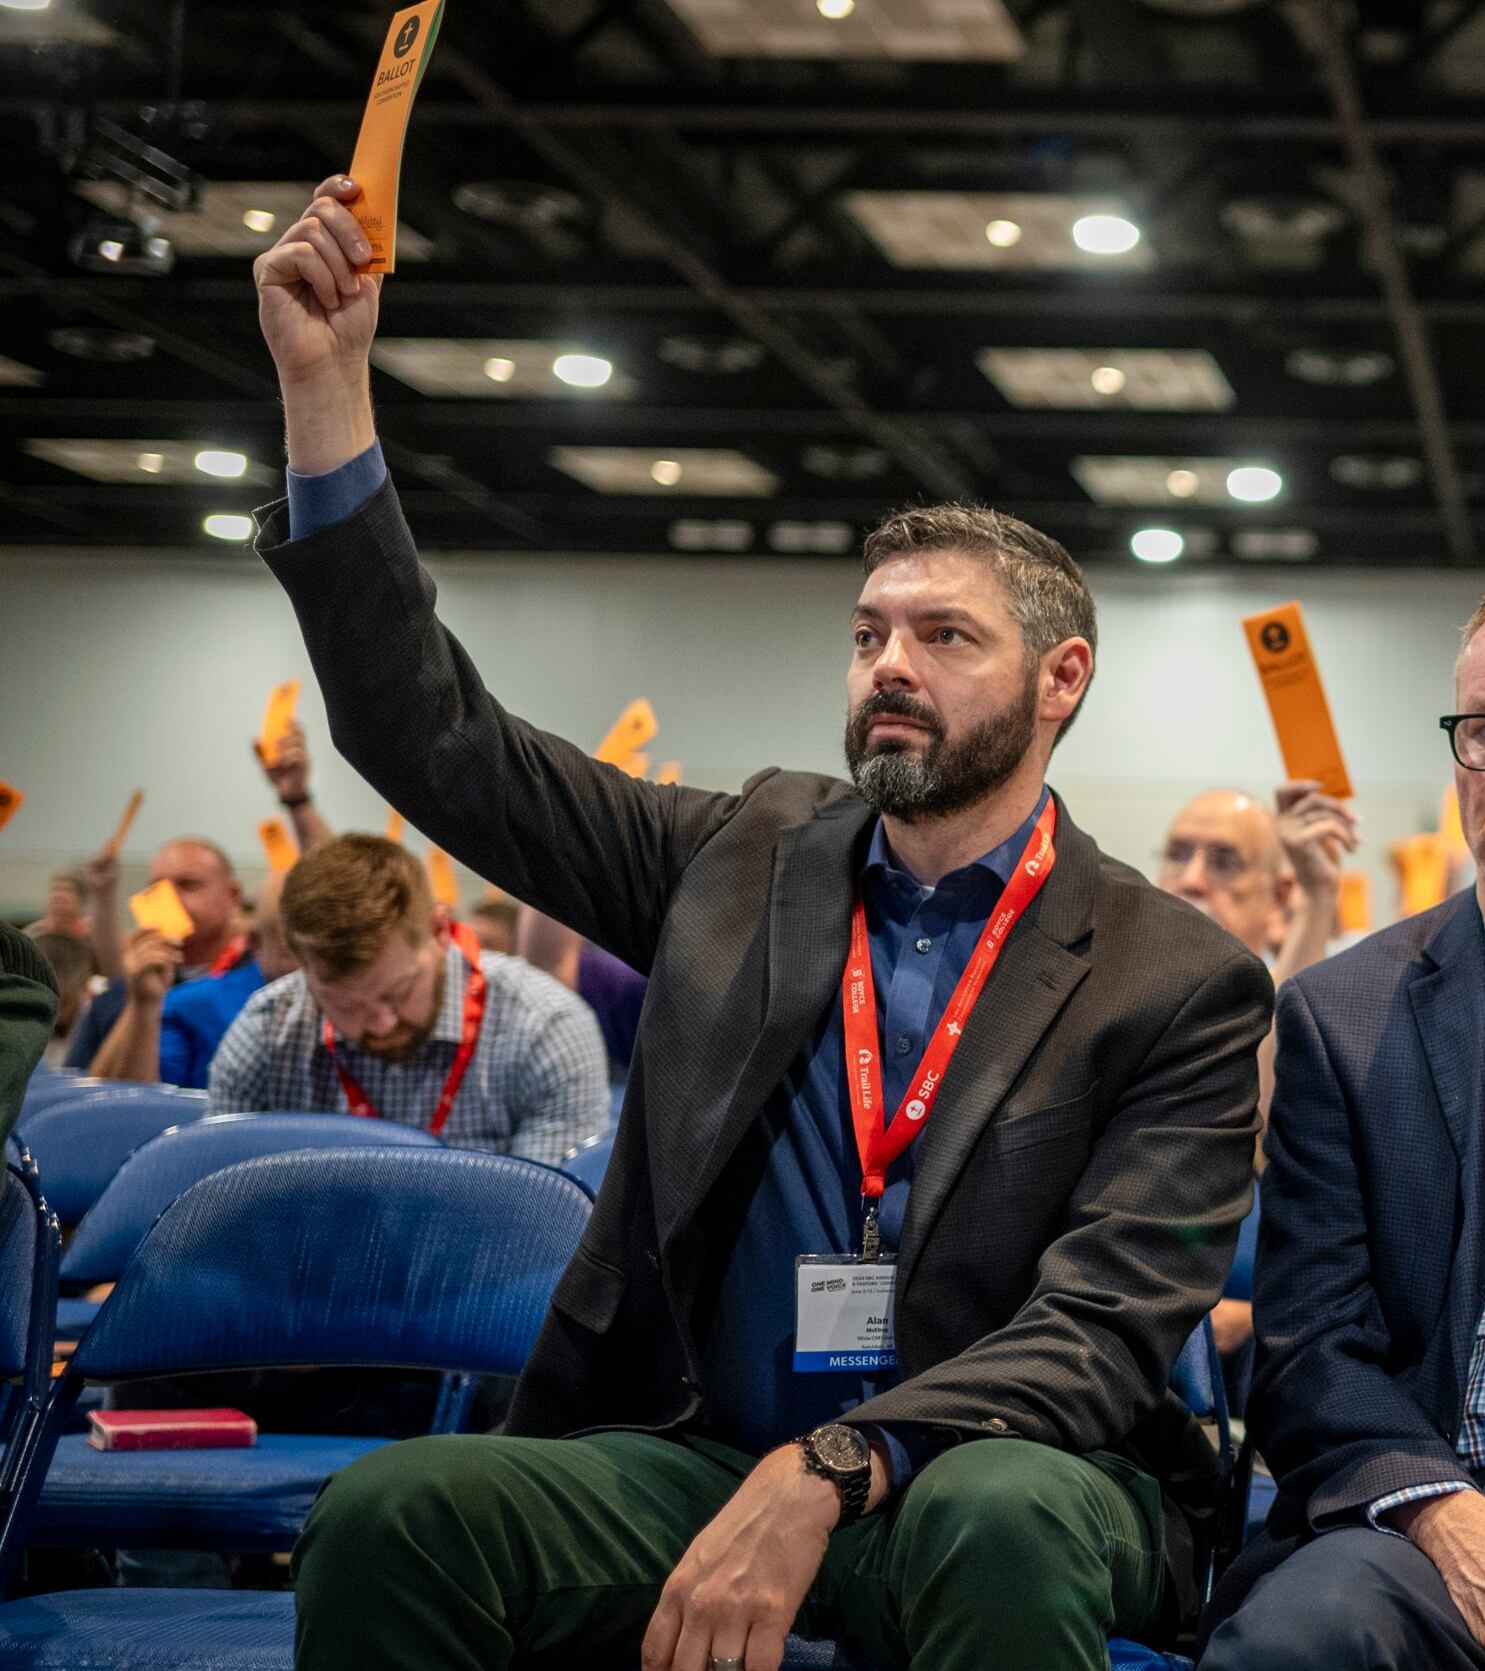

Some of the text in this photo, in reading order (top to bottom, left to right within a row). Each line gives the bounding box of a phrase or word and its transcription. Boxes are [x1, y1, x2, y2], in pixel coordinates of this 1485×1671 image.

[377, 58, 416, 87] BALLOT
[992, 912, 1006, 936] BOYCE
[995, 909, 1015, 939] COLLEGE
[852, 982, 860, 1014] COLLEGE
[858, 980, 866, 1005] BOYCE
[860, 1066, 872, 1110] Trail Life
[918, 1070, 939, 1100] SBC
[866, 1316, 888, 1324] Alan
